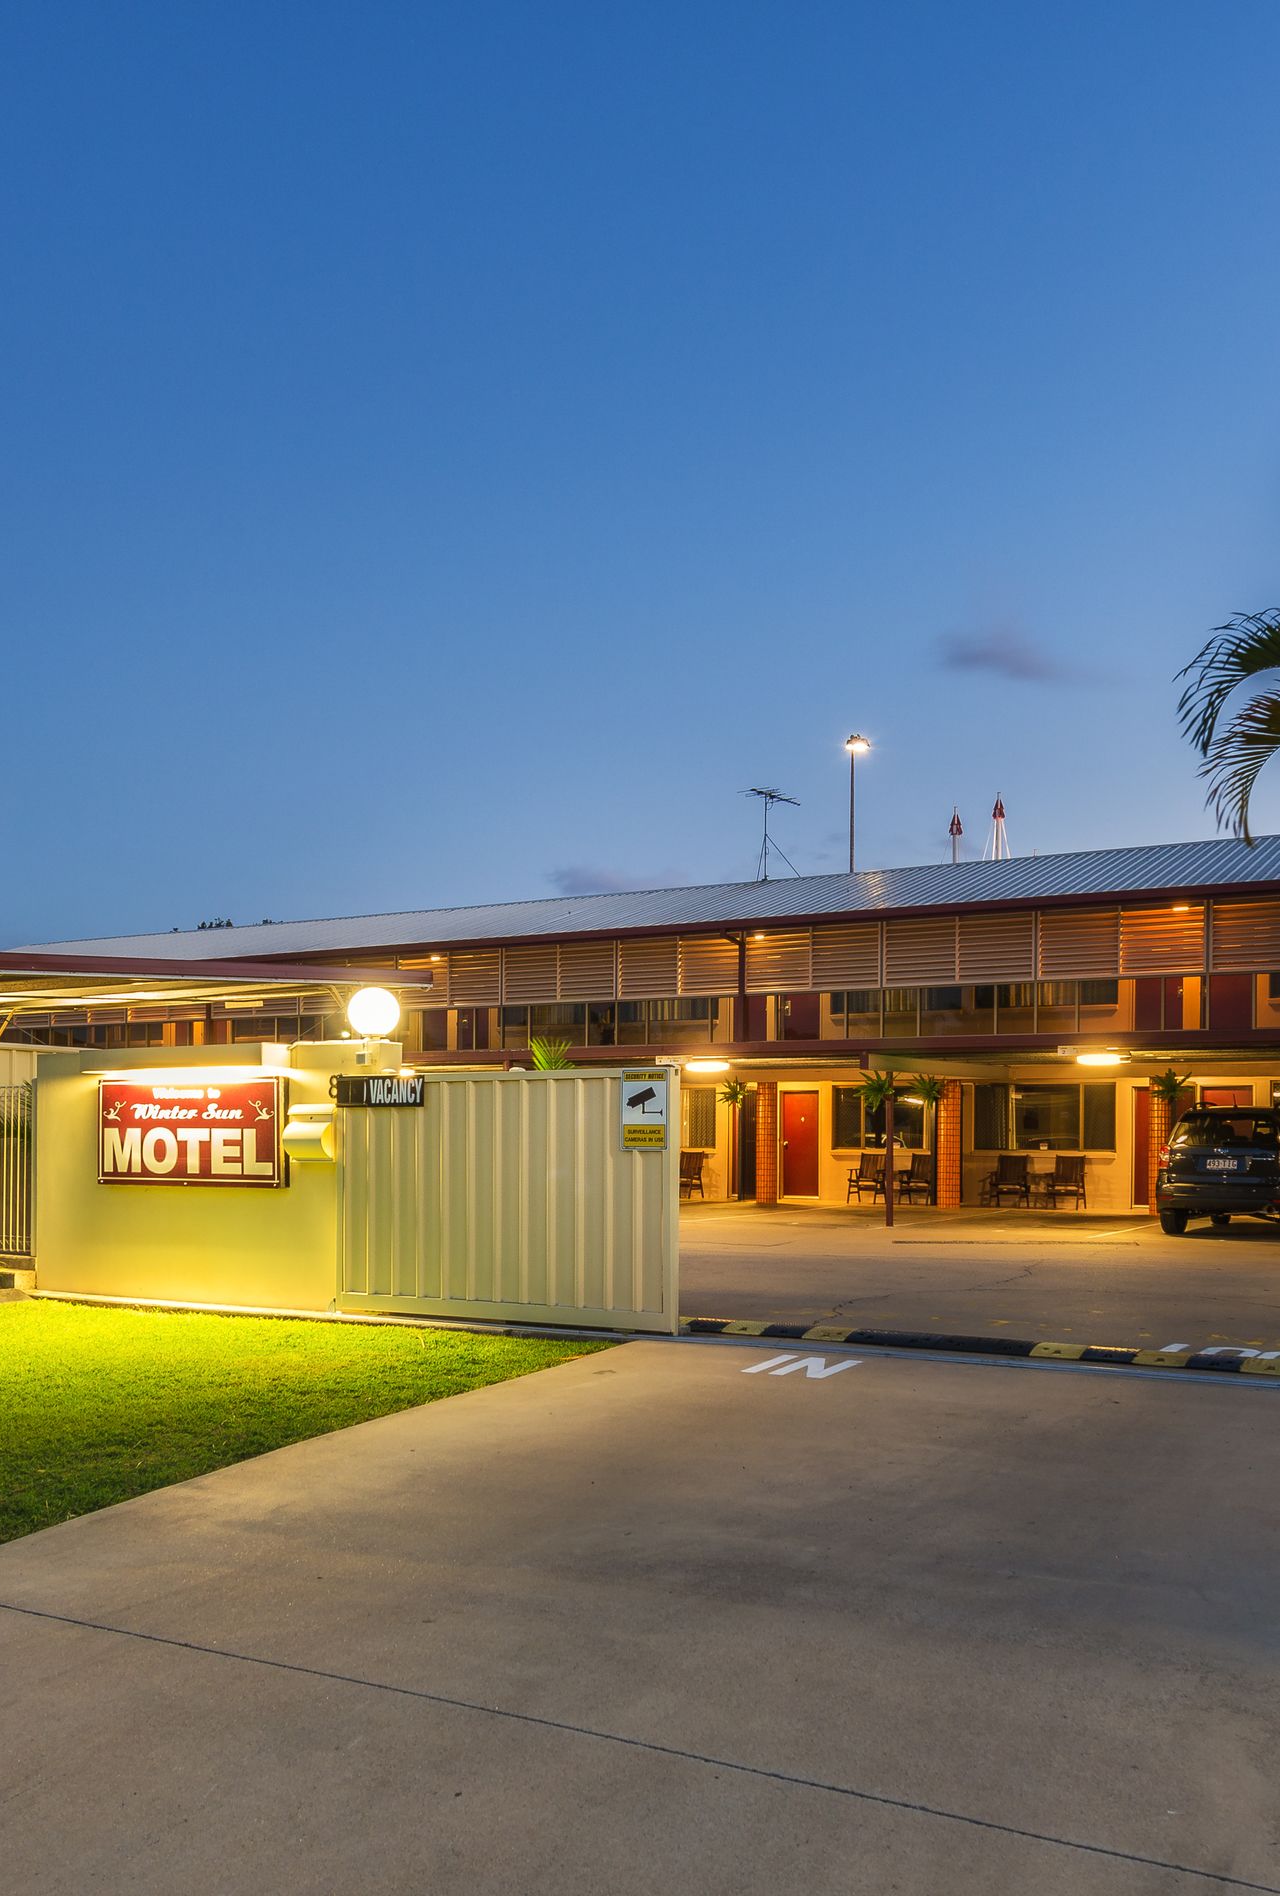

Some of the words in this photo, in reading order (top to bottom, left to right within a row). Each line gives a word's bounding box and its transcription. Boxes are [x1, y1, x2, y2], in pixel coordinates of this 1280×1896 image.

[369, 1078, 423, 1104] VACANCY
[130, 1103, 199, 1120] Winter
[202, 1103, 244, 1120] Sun
[103, 1126, 274, 1176] MOTEL
[740, 1354, 863, 1379] IN
